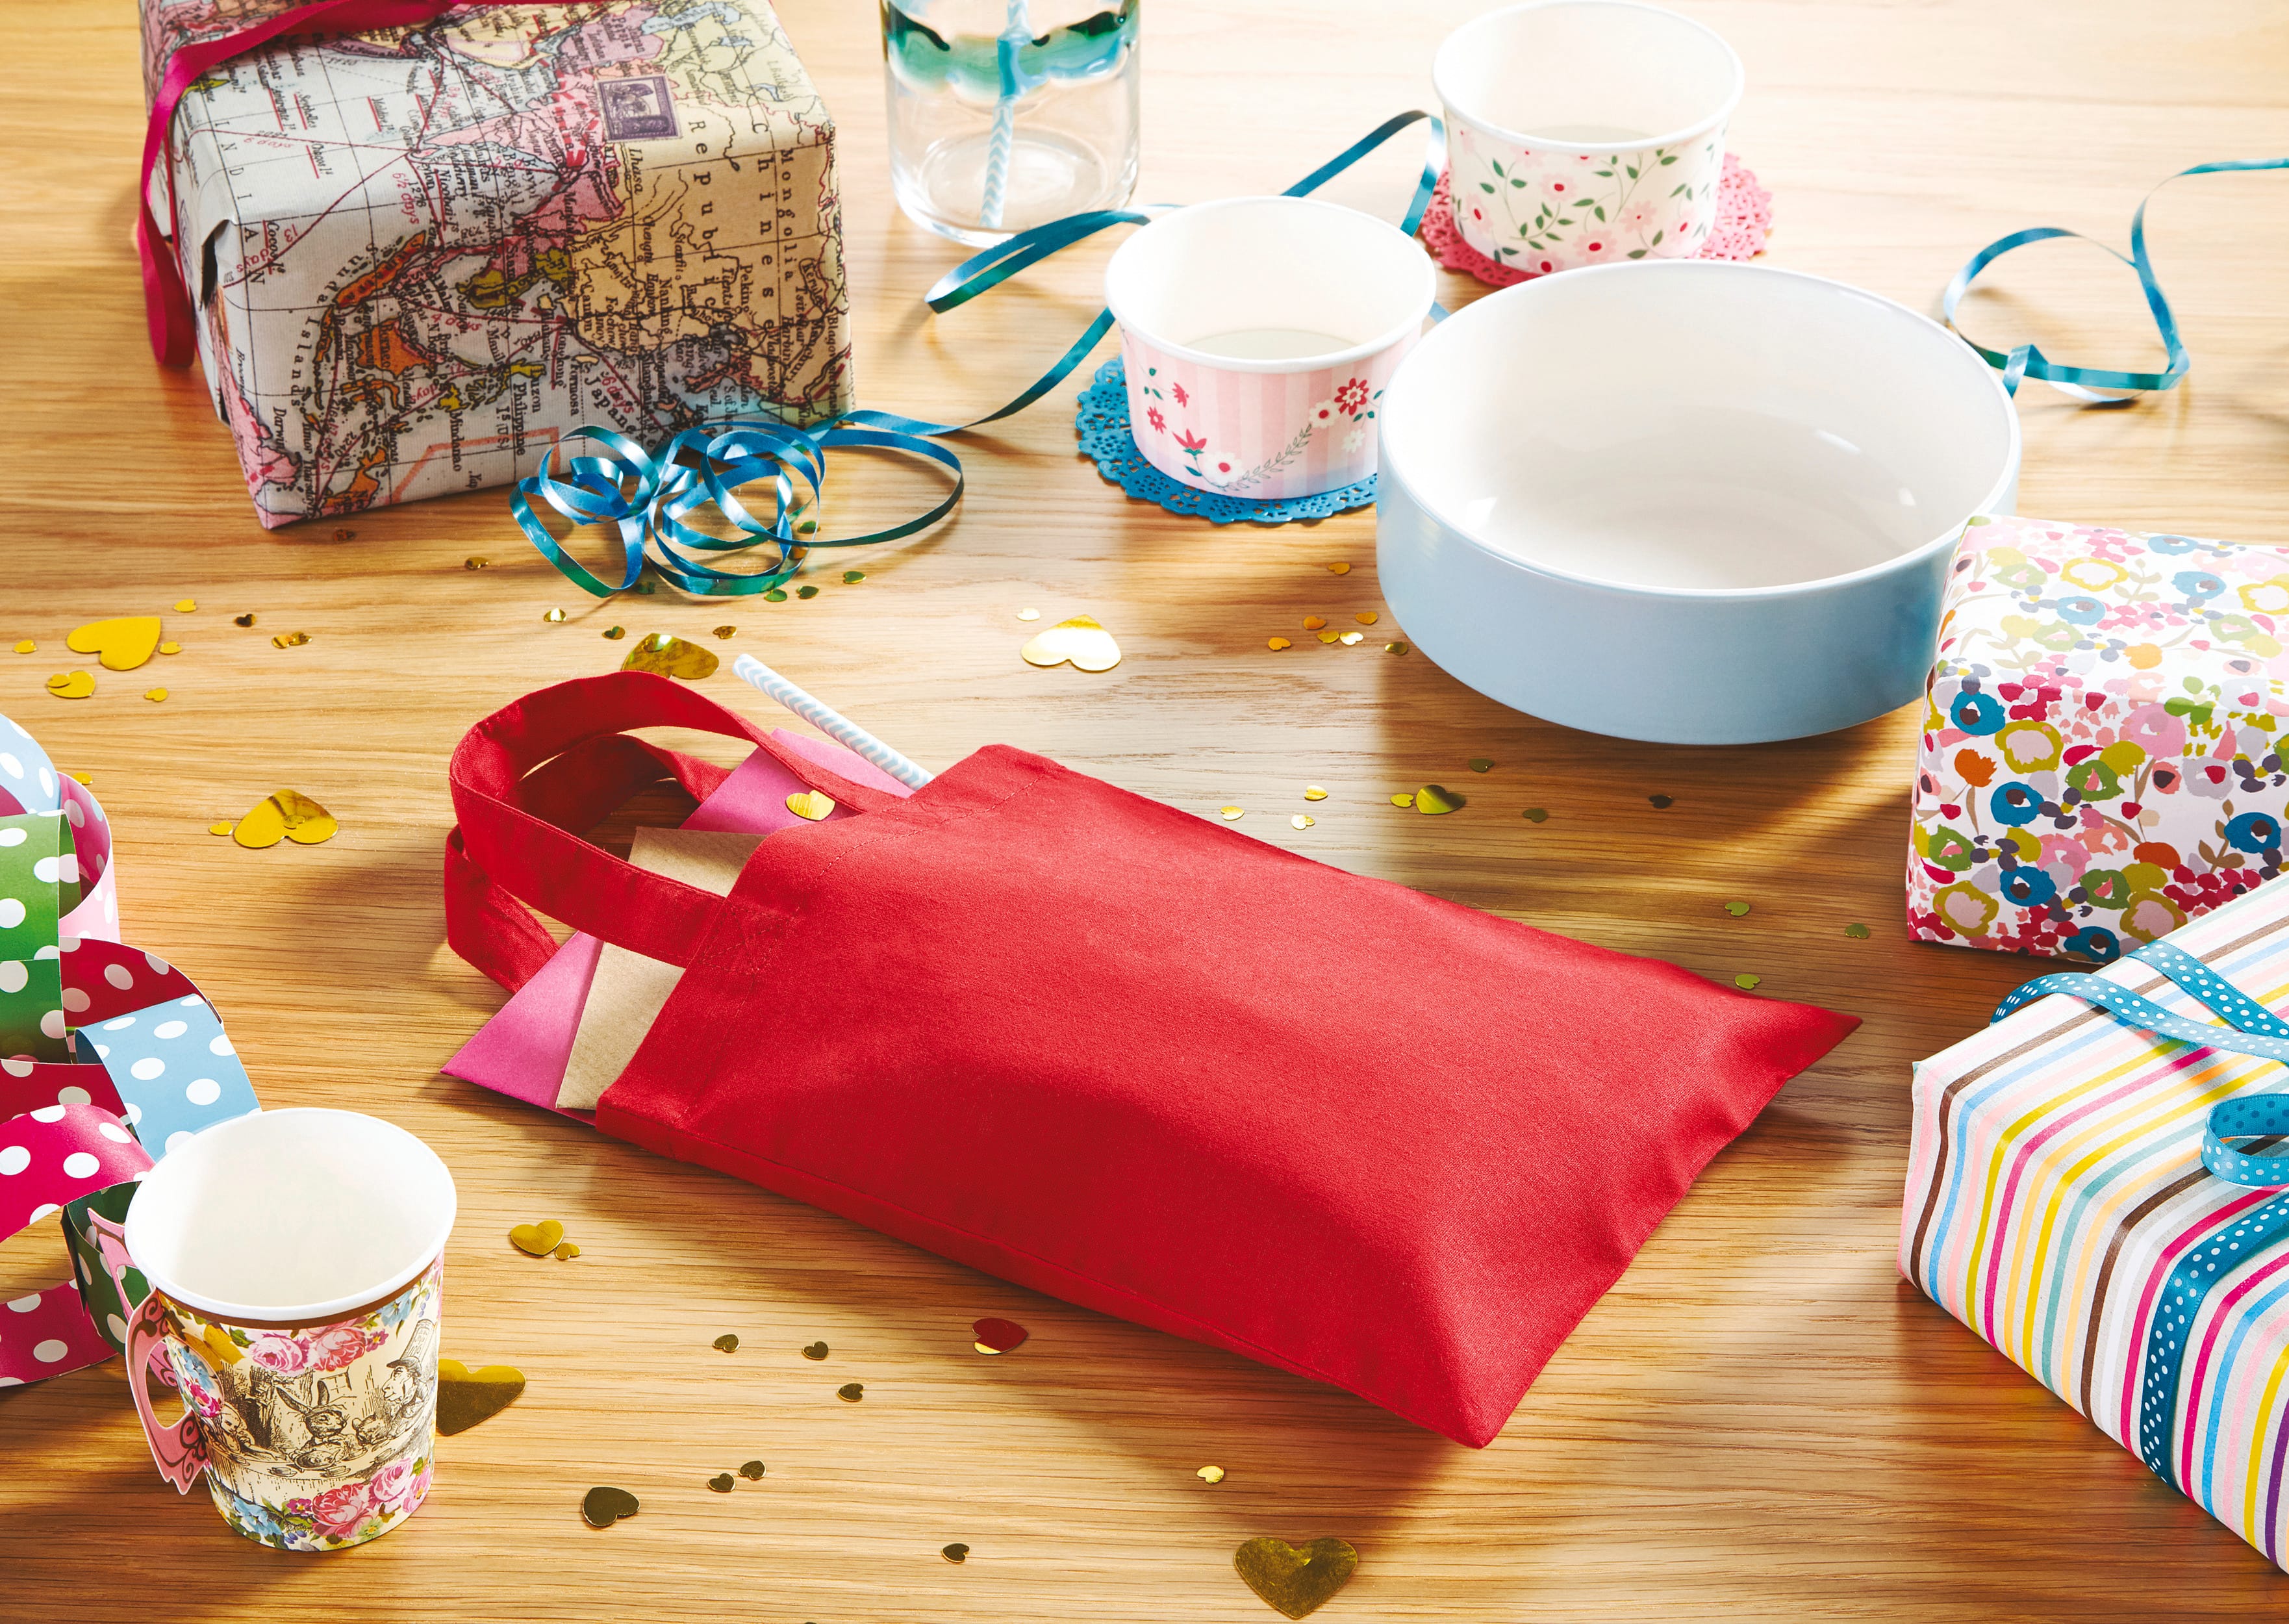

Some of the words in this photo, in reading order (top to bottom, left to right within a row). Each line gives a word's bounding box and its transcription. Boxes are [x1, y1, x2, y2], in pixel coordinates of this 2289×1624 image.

[612, 17, 632, 49] Persia
[629, 148, 644, 195] Lhasa
[401, 193, 420, 224] days
[776, 148, 798, 282] Mongolia
[236, 248, 270, 273] days
[268, 222, 281, 259] Cocos
[657, 277, 673, 335] Nanking
[740, 264, 753, 313] Peking
[290, 316, 320, 407] Islands
[381, 324, 396, 368] Borneo
[553, 327, 572, 389] Hongkong
[781, 315, 794, 362] Harbin
[568, 361, 584, 416] Formosa
[273, 407, 287, 450] Darwin
[302, 422, 314, 454] Timor
[449, 410, 465, 472] Mindanao
[512, 382, 528, 456] Philippine
[335, 431, 357, 457] 2240
